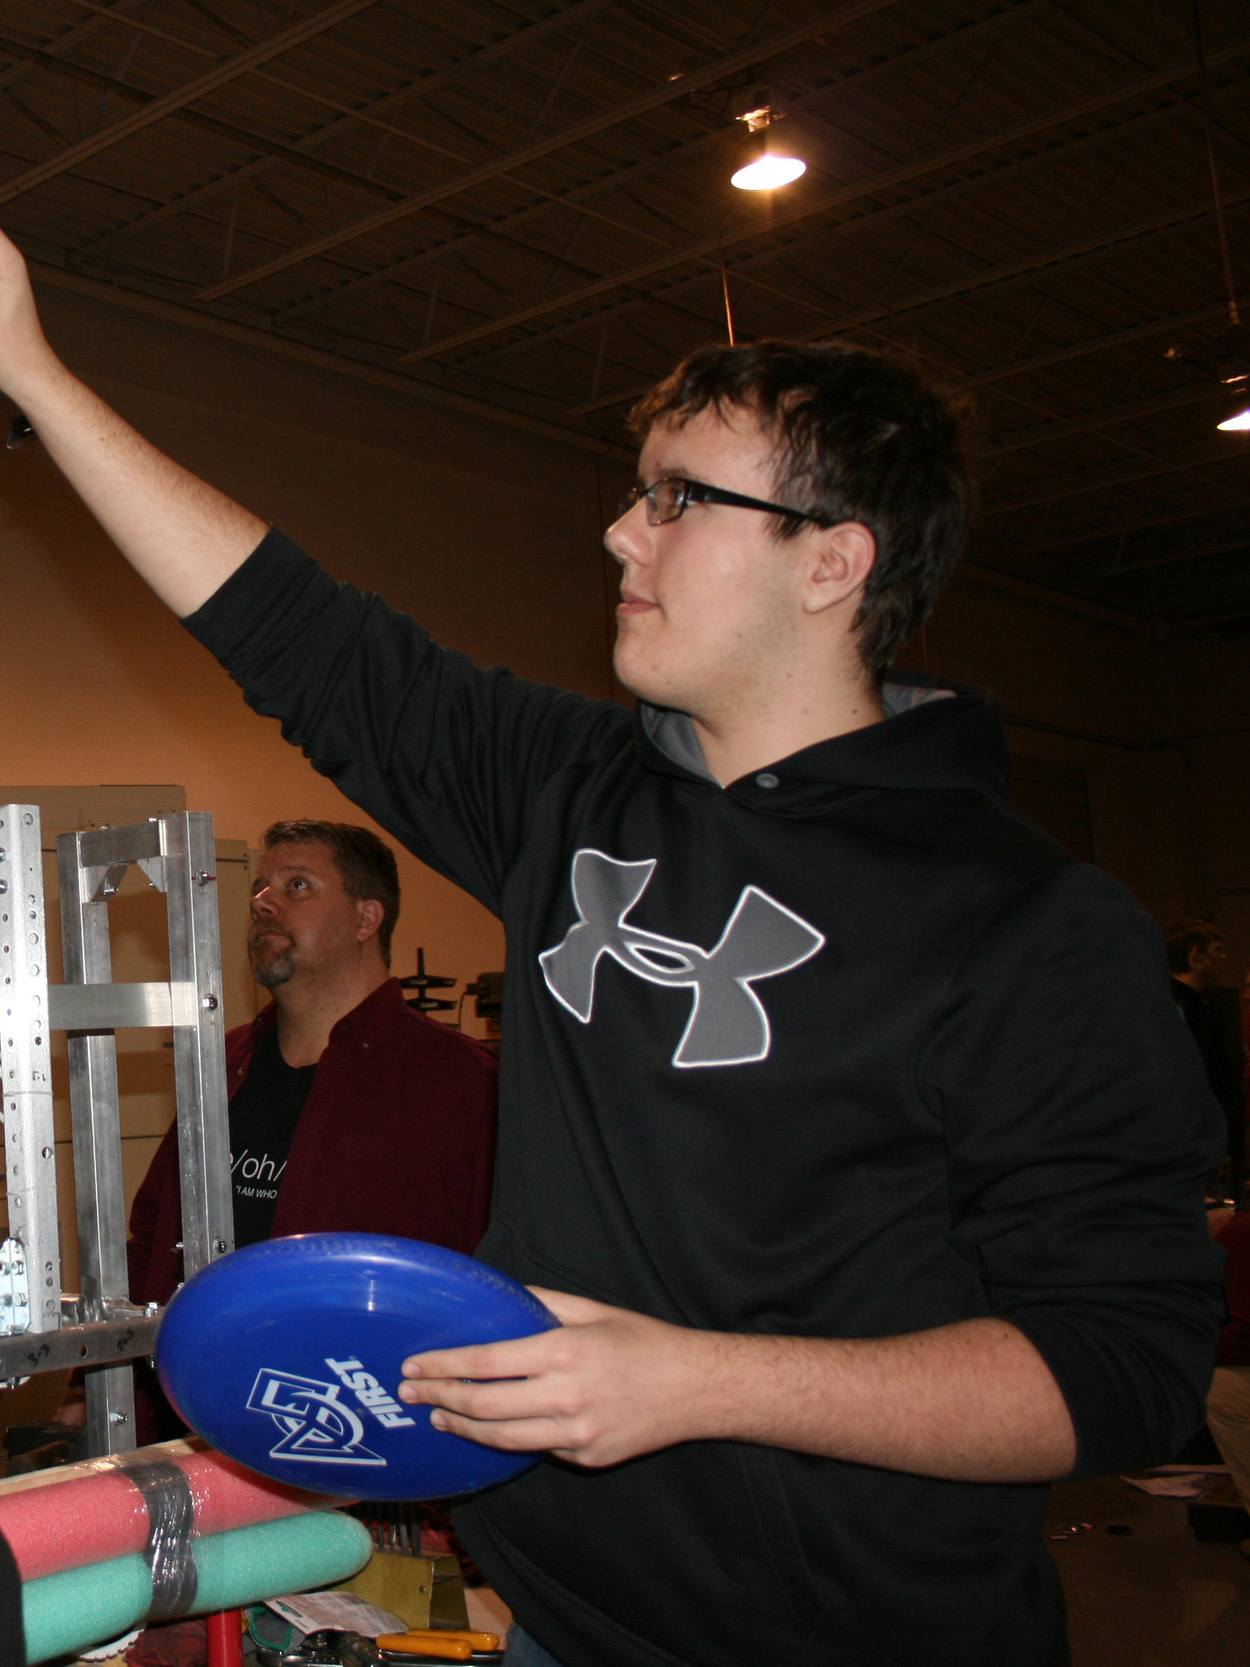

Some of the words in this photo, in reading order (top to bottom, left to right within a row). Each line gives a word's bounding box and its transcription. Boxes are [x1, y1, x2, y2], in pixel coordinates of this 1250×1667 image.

[241, 1187, 255, 1198] AM
[256, 1189, 278, 1199] WHO
[324, 1358, 416, 1428] FIRST
